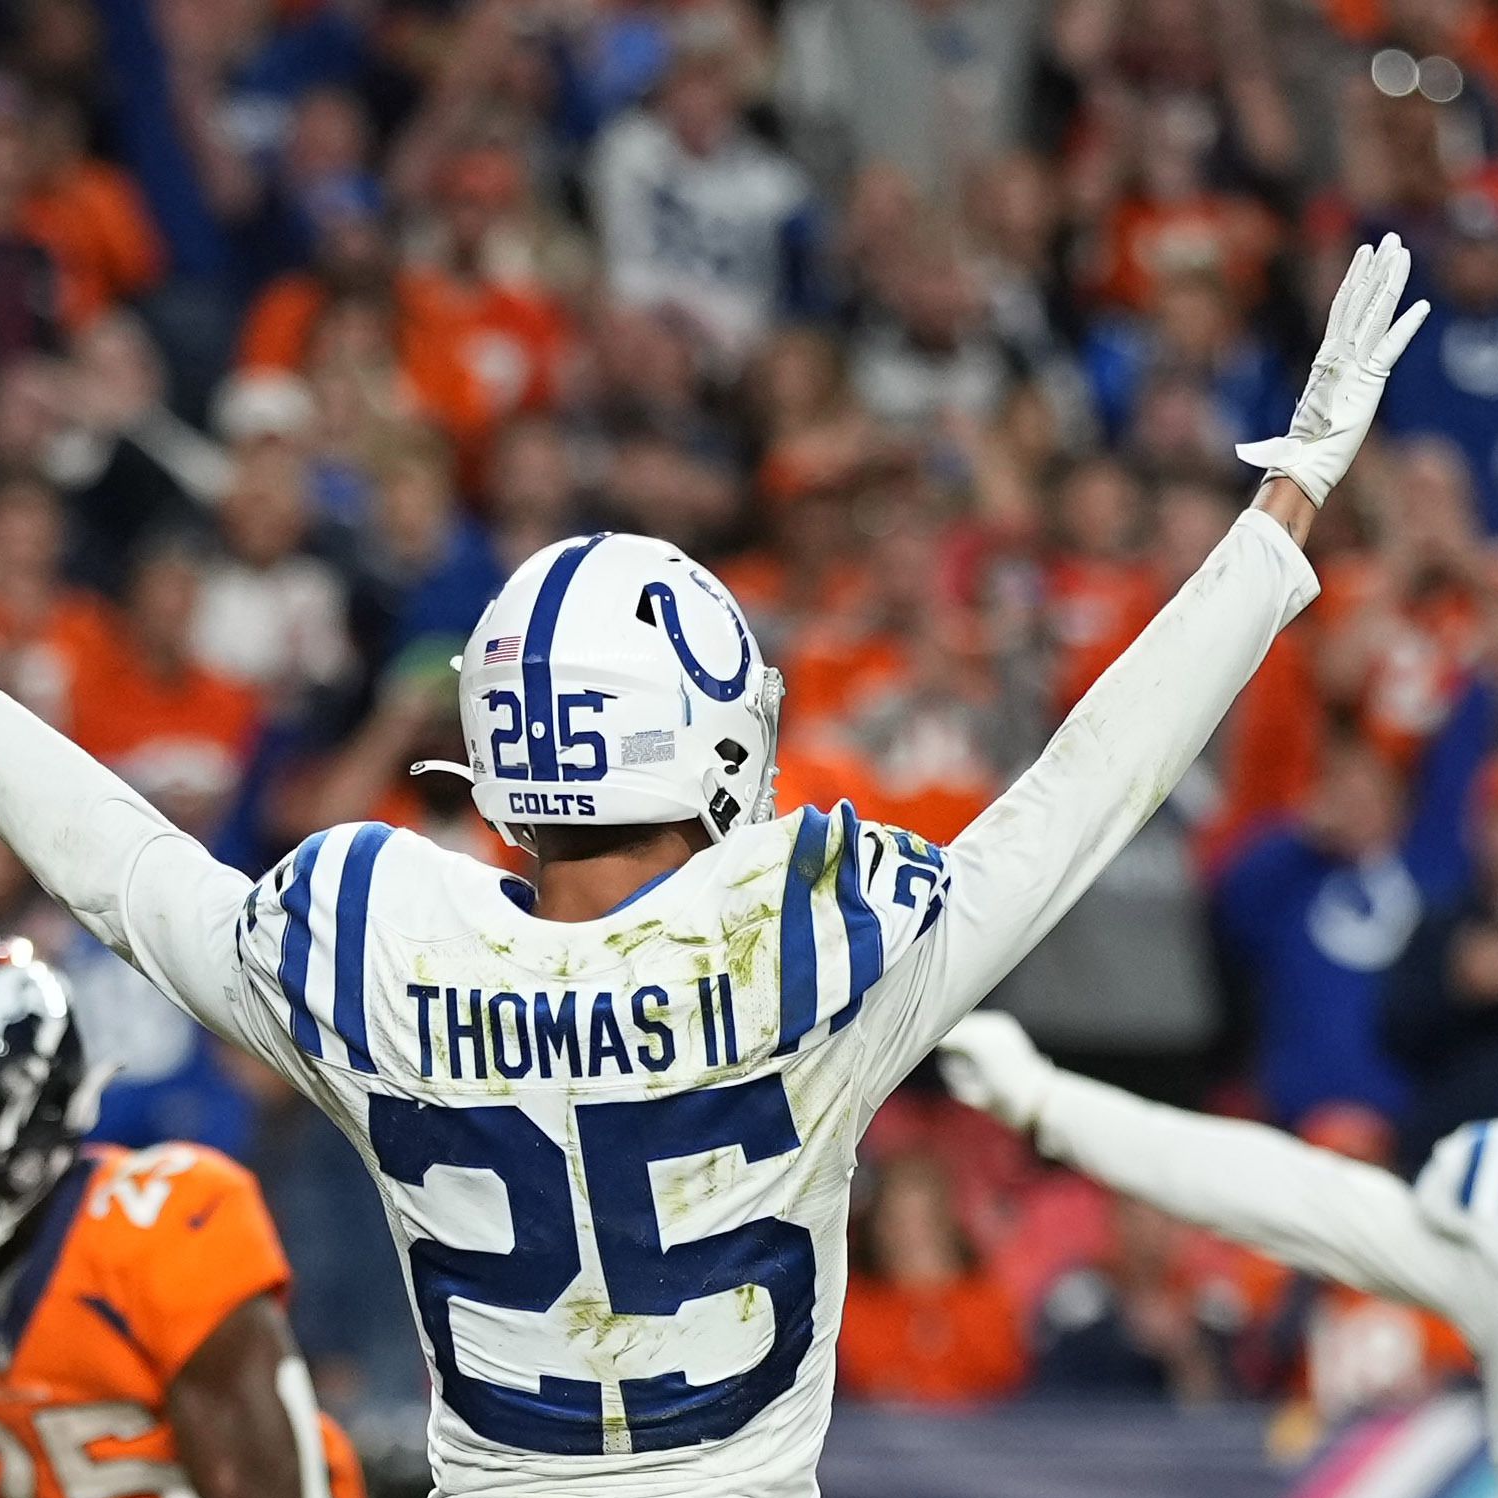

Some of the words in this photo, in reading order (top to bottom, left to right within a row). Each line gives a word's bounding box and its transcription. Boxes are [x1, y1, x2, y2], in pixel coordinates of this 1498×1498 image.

[486, 690, 608, 782] 25
[509, 792, 596, 816] COLTS
[408, 984, 675, 1080] THOMAS
[700, 973, 739, 1067] II
[369, 1074, 816, 1456] 25
